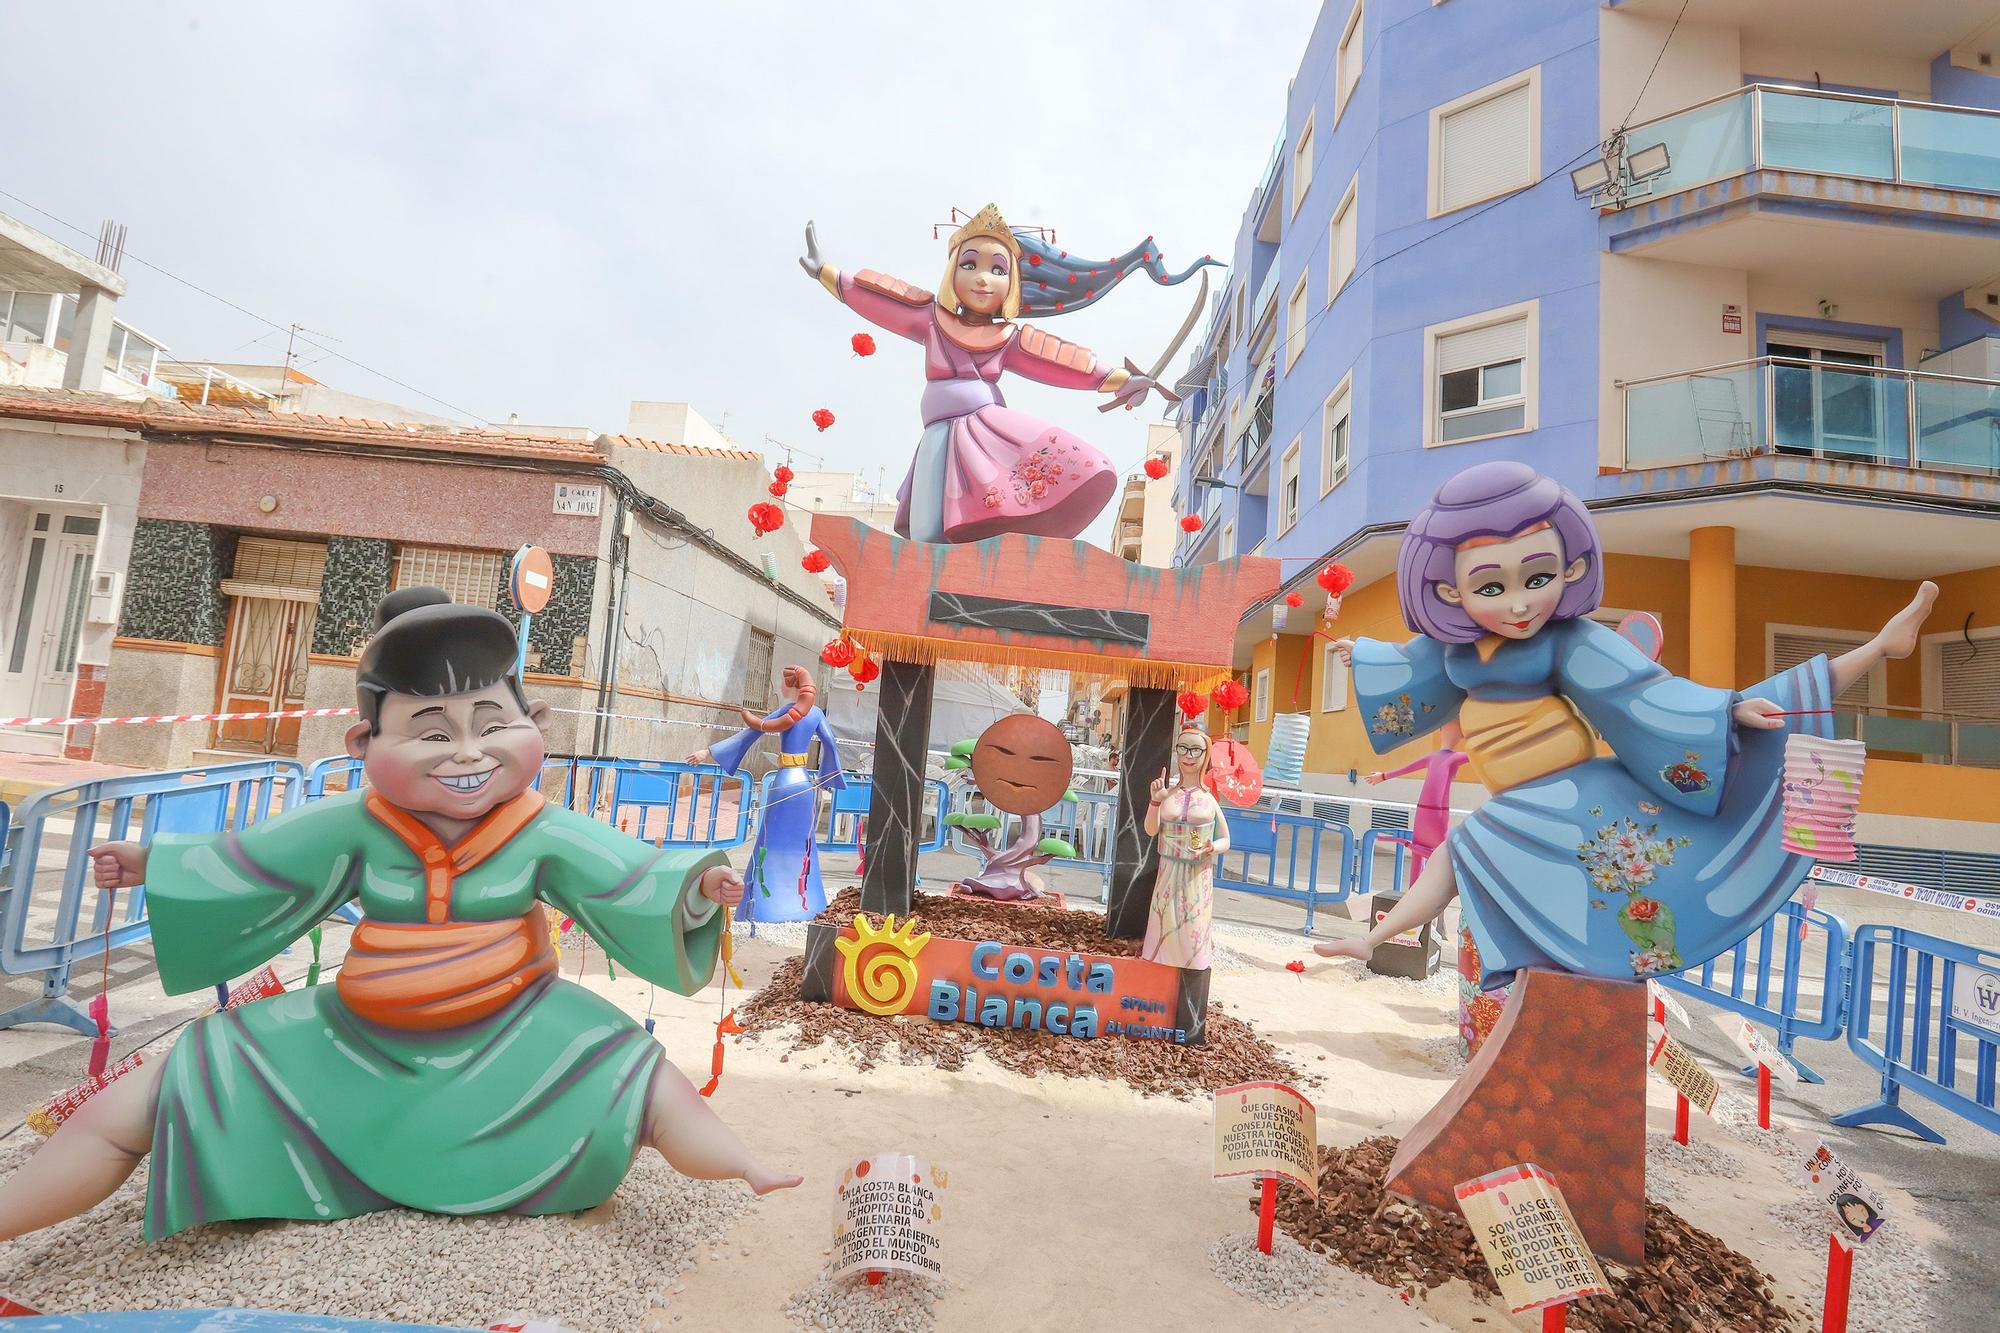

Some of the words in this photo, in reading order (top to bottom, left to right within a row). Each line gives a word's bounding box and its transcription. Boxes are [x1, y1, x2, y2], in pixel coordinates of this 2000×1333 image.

[55, 485, 63, 493] 15
[572, 489, 595, 497] CALLE
[557, 500, 572, 510] SAN
[1821, 868, 1838, 881] LOCAL
[1873, 879, 1888, 887] PASO
[1867, 883, 1900, 895] PROHIBIDO
[1915, 887, 1935, 902] LOCAL
[971, 940, 1115, 995] Costa
[927, 977, 1099, 1038] Blanca
[1120, 995, 1168, 1014] SPAIN
[1105, 1020, 1186, 1043] ALICANTE
[1241, 1104, 1260, 1114] QUE
[1262, 1103, 1304, 1124] GRASIOSA
[1253, 1112, 1296, 1128] NUESTRA
[1231, 1121, 1286, 1133] CONSEJALA
[1286, 1126, 1301, 1141] QUE
[1222, 1139, 1250, 1153] PODIA
[1223, 1130, 1265, 1143] NUESTRA
[1267, 1130, 1306, 1152] HOGUERA
[1227, 1149, 1254, 1161] VISTO
[1255, 1148, 1269, 1158] EN
[1270, 1149, 1296, 1164] OTRA
[1804, 1159, 1815, 1171] UN
[842, 1190, 850, 1201] EN
[851, 1185, 861, 1195] LA
[863, 1181, 895, 1193] COSTA
[898, 1182, 934, 1202] BLANCA
[1826, 1190, 1840, 1205] LOS
[849, 1192, 895, 1208] HACEMOS
[897, 1193, 923, 1209] GALA
[1511, 1200, 1536, 1217] LAS
[847, 1209, 856, 1220] DE
[857, 1203, 925, 1220] HOPITALIDAD
[855, 1214, 911, 1228] MILENARIA
[1488, 1220, 1515, 1238] SON
[834, 1230, 856, 1249] SOMOS
[856, 1225, 896, 1238] GENTES
[899, 1227, 940, 1249] ABIERTAS
[1489, 1240, 1498, 1251] Y
[1500, 1234, 1517, 1248] EN
[842, 1246, 847, 1256] A
[848, 1238, 870, 1254] TODO
[872, 1237, 885, 1248] EL
[887, 1239, 927, 1256] MUNDO
[1501, 1246, 1522, 1262] NO
[1522, 1235, 1561, 1255] PODIA
[865, 1249, 888, 1260] POR
[890, 1250, 941, 1274] DESCUBRIR
[1494, 1264, 1515, 1280] ASI
[1515, 1255, 1542, 1272] QUE
[1542, 1250, 1559, 1264] LE
[1523, 1266, 1551, 1284] QUE
[1554, 1275, 1575, 1290] DE
